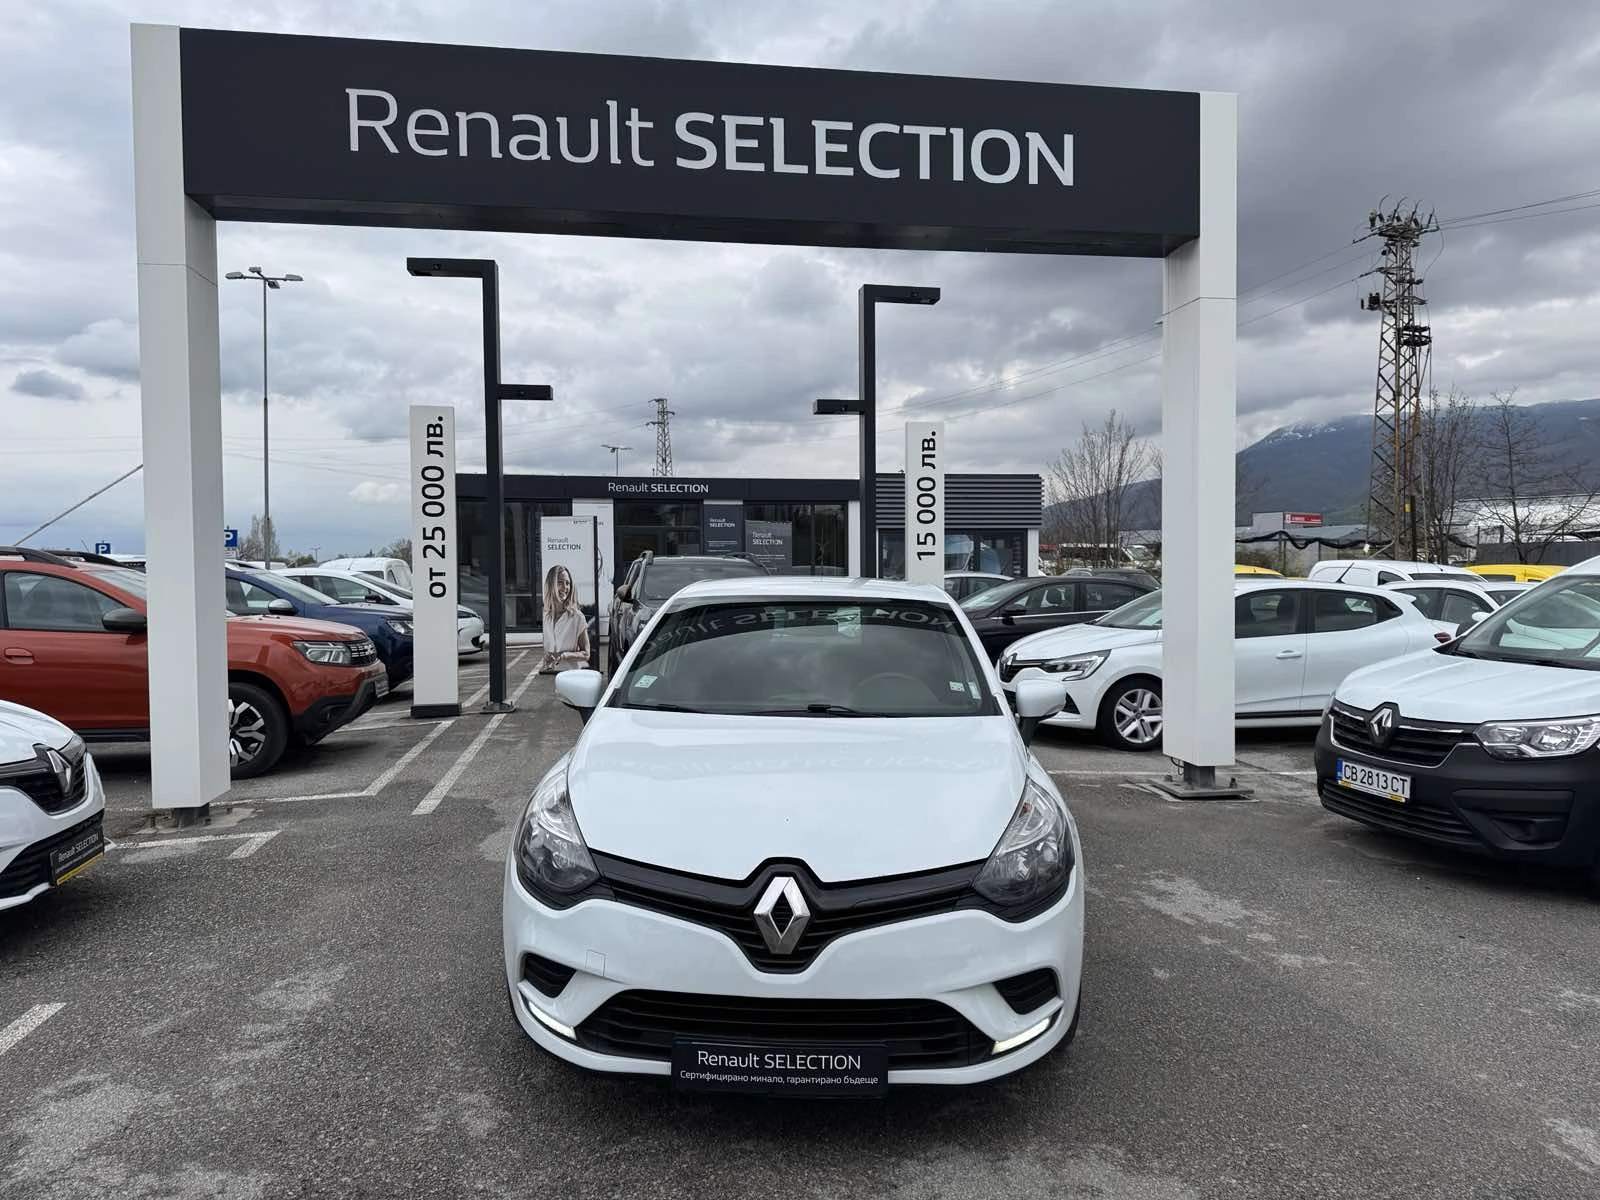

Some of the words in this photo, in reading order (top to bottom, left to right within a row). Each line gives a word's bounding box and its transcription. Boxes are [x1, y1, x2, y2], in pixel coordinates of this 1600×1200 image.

[346, 88, 654, 167] Renault
[675, 112, 1075, 187] SELECTION
[426, 416, 444, 458] лв.
[921, 431, 937, 470] лв.
[421, 465, 445, 518] 000
[608, 482, 649, 493] Renault
[650, 483, 709, 493] SELECTION
[916, 477, 936, 524] 000
[98, 544, 108, 554] P
[423, 526, 446, 559] 25
[916, 532, 936, 561] 15
[429, 567, 447, 598] от
[1344, 765, 1358, 781] CB
[1360, 768, 1388, 789] 2813
[1391, 776, 1408, 795] CT
[698, 1050, 760, 1069] Renault
[764, 1053, 861, 1070] SELECTION
[680, 1070, 749, 1083] Сертифицирано
[750, 1075, 785, 1084] минало,
[786, 1076, 842, 1085] гарантирано
[844, 1075, 879, 1085] бъдеще
